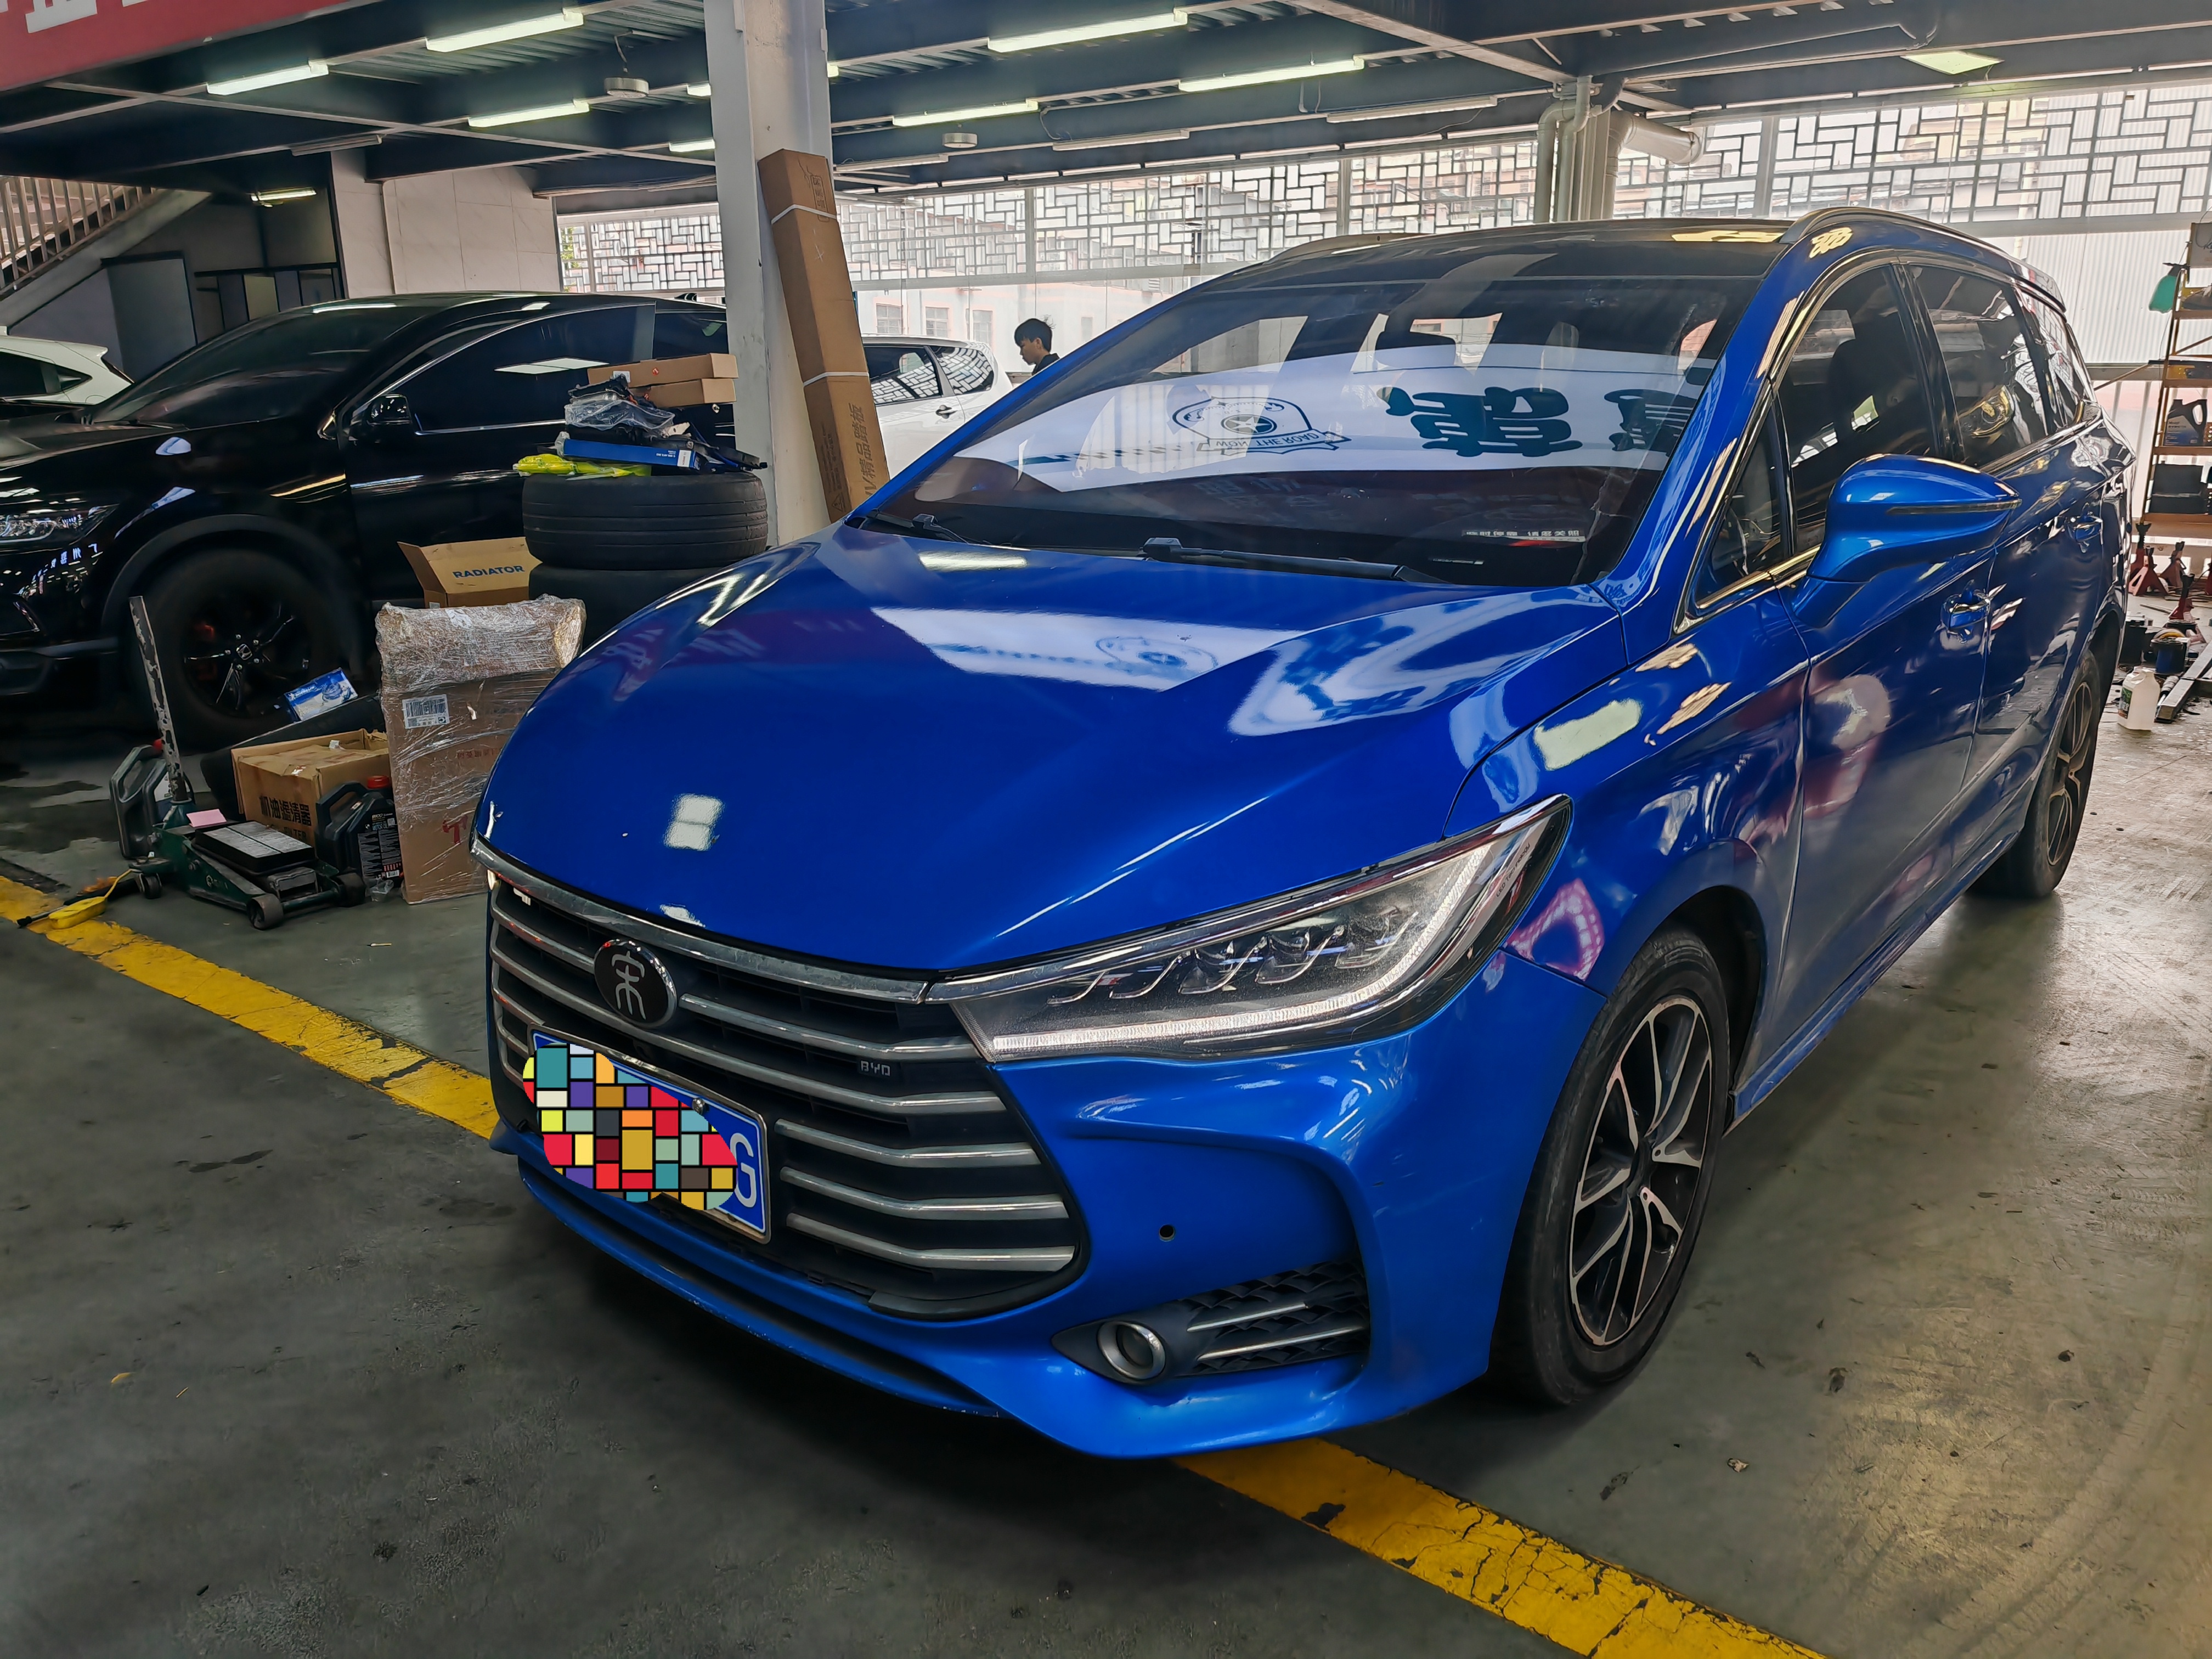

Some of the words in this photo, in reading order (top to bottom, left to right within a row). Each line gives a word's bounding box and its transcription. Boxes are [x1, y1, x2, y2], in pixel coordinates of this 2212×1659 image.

[453, 565, 525, 578] RADIATOR
[259, 795, 312, 826] 机油滤清器
[1496, 883, 1506, 898] LED
[1505, 843, 1531, 882] Tecnology
[860, 1060, 891, 1077] BYD
